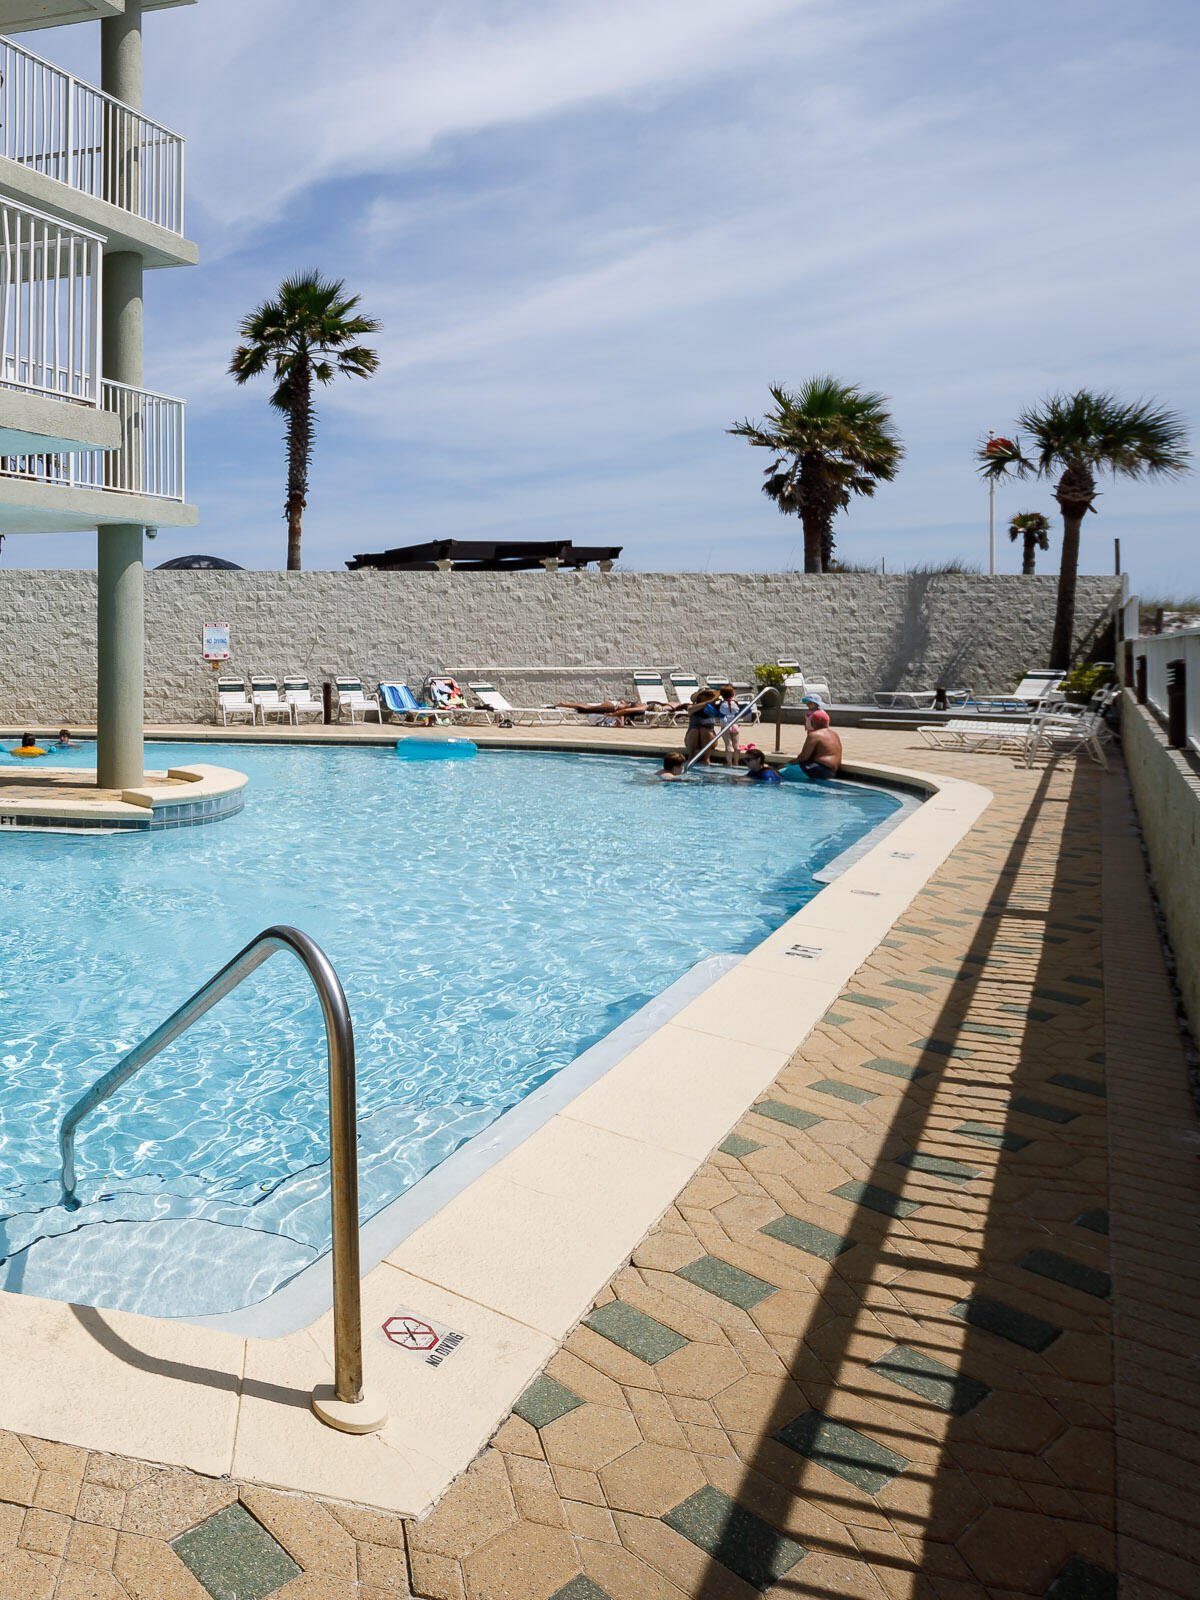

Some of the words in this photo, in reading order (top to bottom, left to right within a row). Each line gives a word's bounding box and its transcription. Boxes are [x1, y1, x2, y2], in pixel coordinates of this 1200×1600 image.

[0, 816, 15, 825] FT
[425, 1354, 444, 1368] NO
[435, 1331, 464, 1357] DIVING
